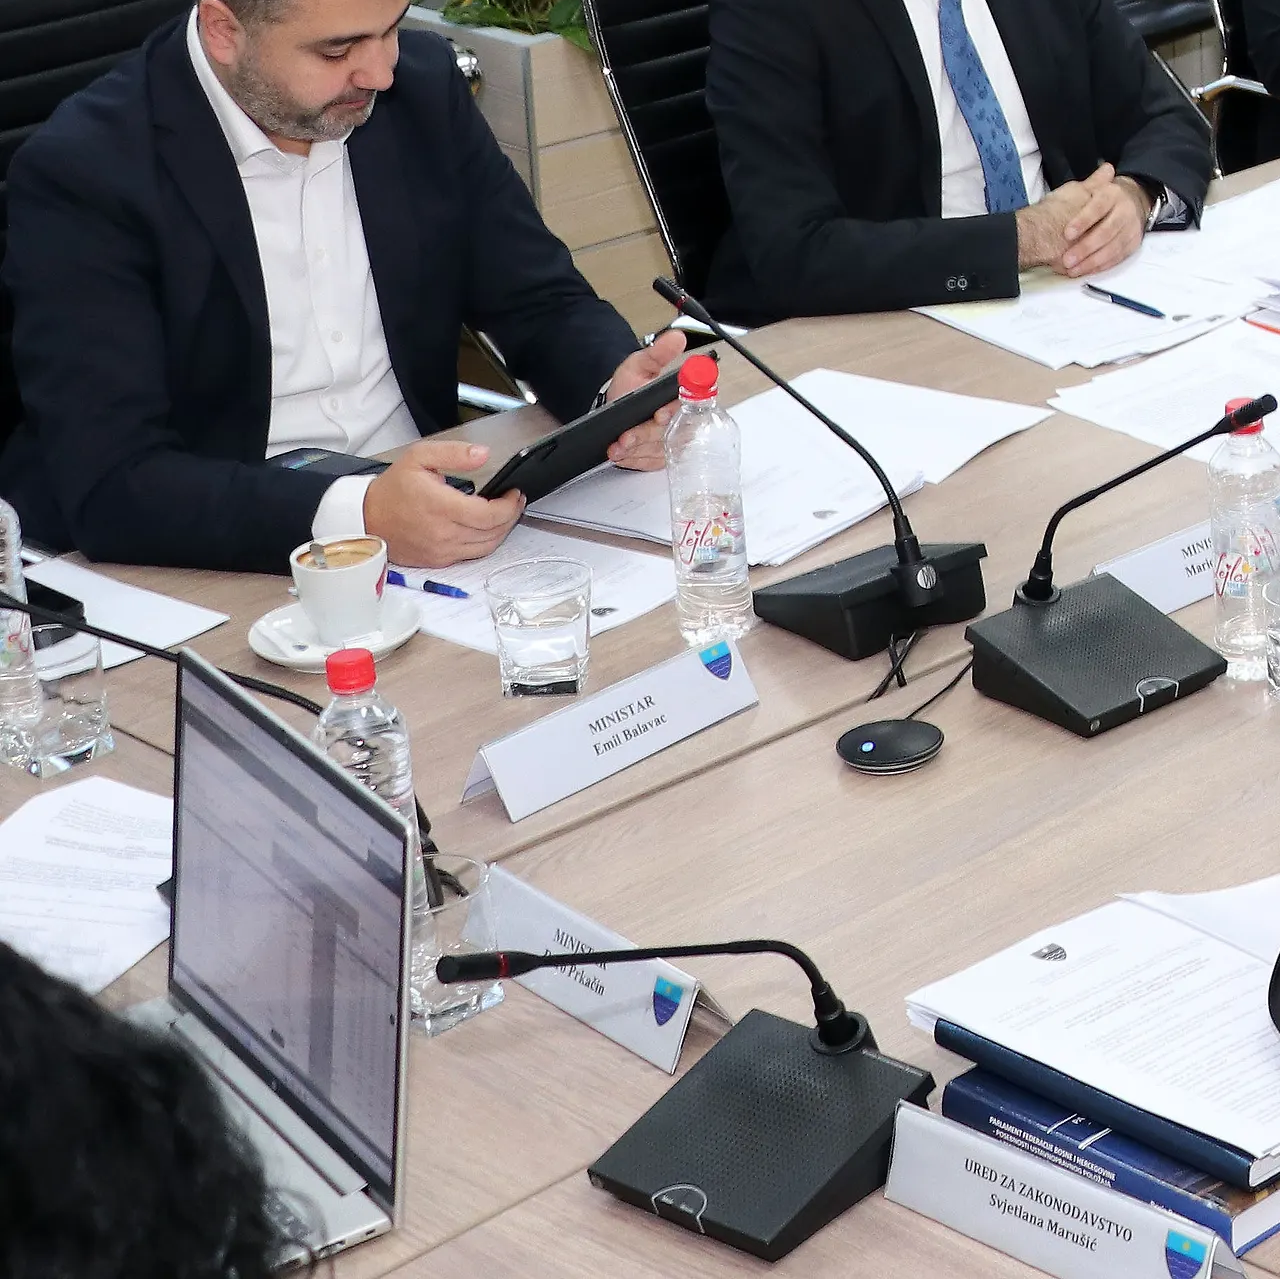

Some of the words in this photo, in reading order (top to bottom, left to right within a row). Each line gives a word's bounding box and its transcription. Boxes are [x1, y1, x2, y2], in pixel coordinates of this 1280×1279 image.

[679, 519, 718, 566] Lejla
[588, 694, 656, 736] MINISTAR
[593, 733, 622, 757] Emil
[622, 713, 668, 742] Balavac
[567, 964, 606, 997] Prkačin
[988, 1115, 1023, 1138] PARLAMENT
[1022, 1130, 1054, 1153] FEDERACIJE
[1053, 1145, 1074, 1162] BOSNE
[1076, 1156, 1117, 1182] HERCEGOVINE
[964, 1157, 998, 1183] URED
[1000, 1173, 1018, 1192] ZA
[1018, 1181, 1133, 1243] ZAKONODAVSTVO
[989, 1193, 1044, 1230] Svjetlana
[1046, 1218, 1098, 1253] Marušić
